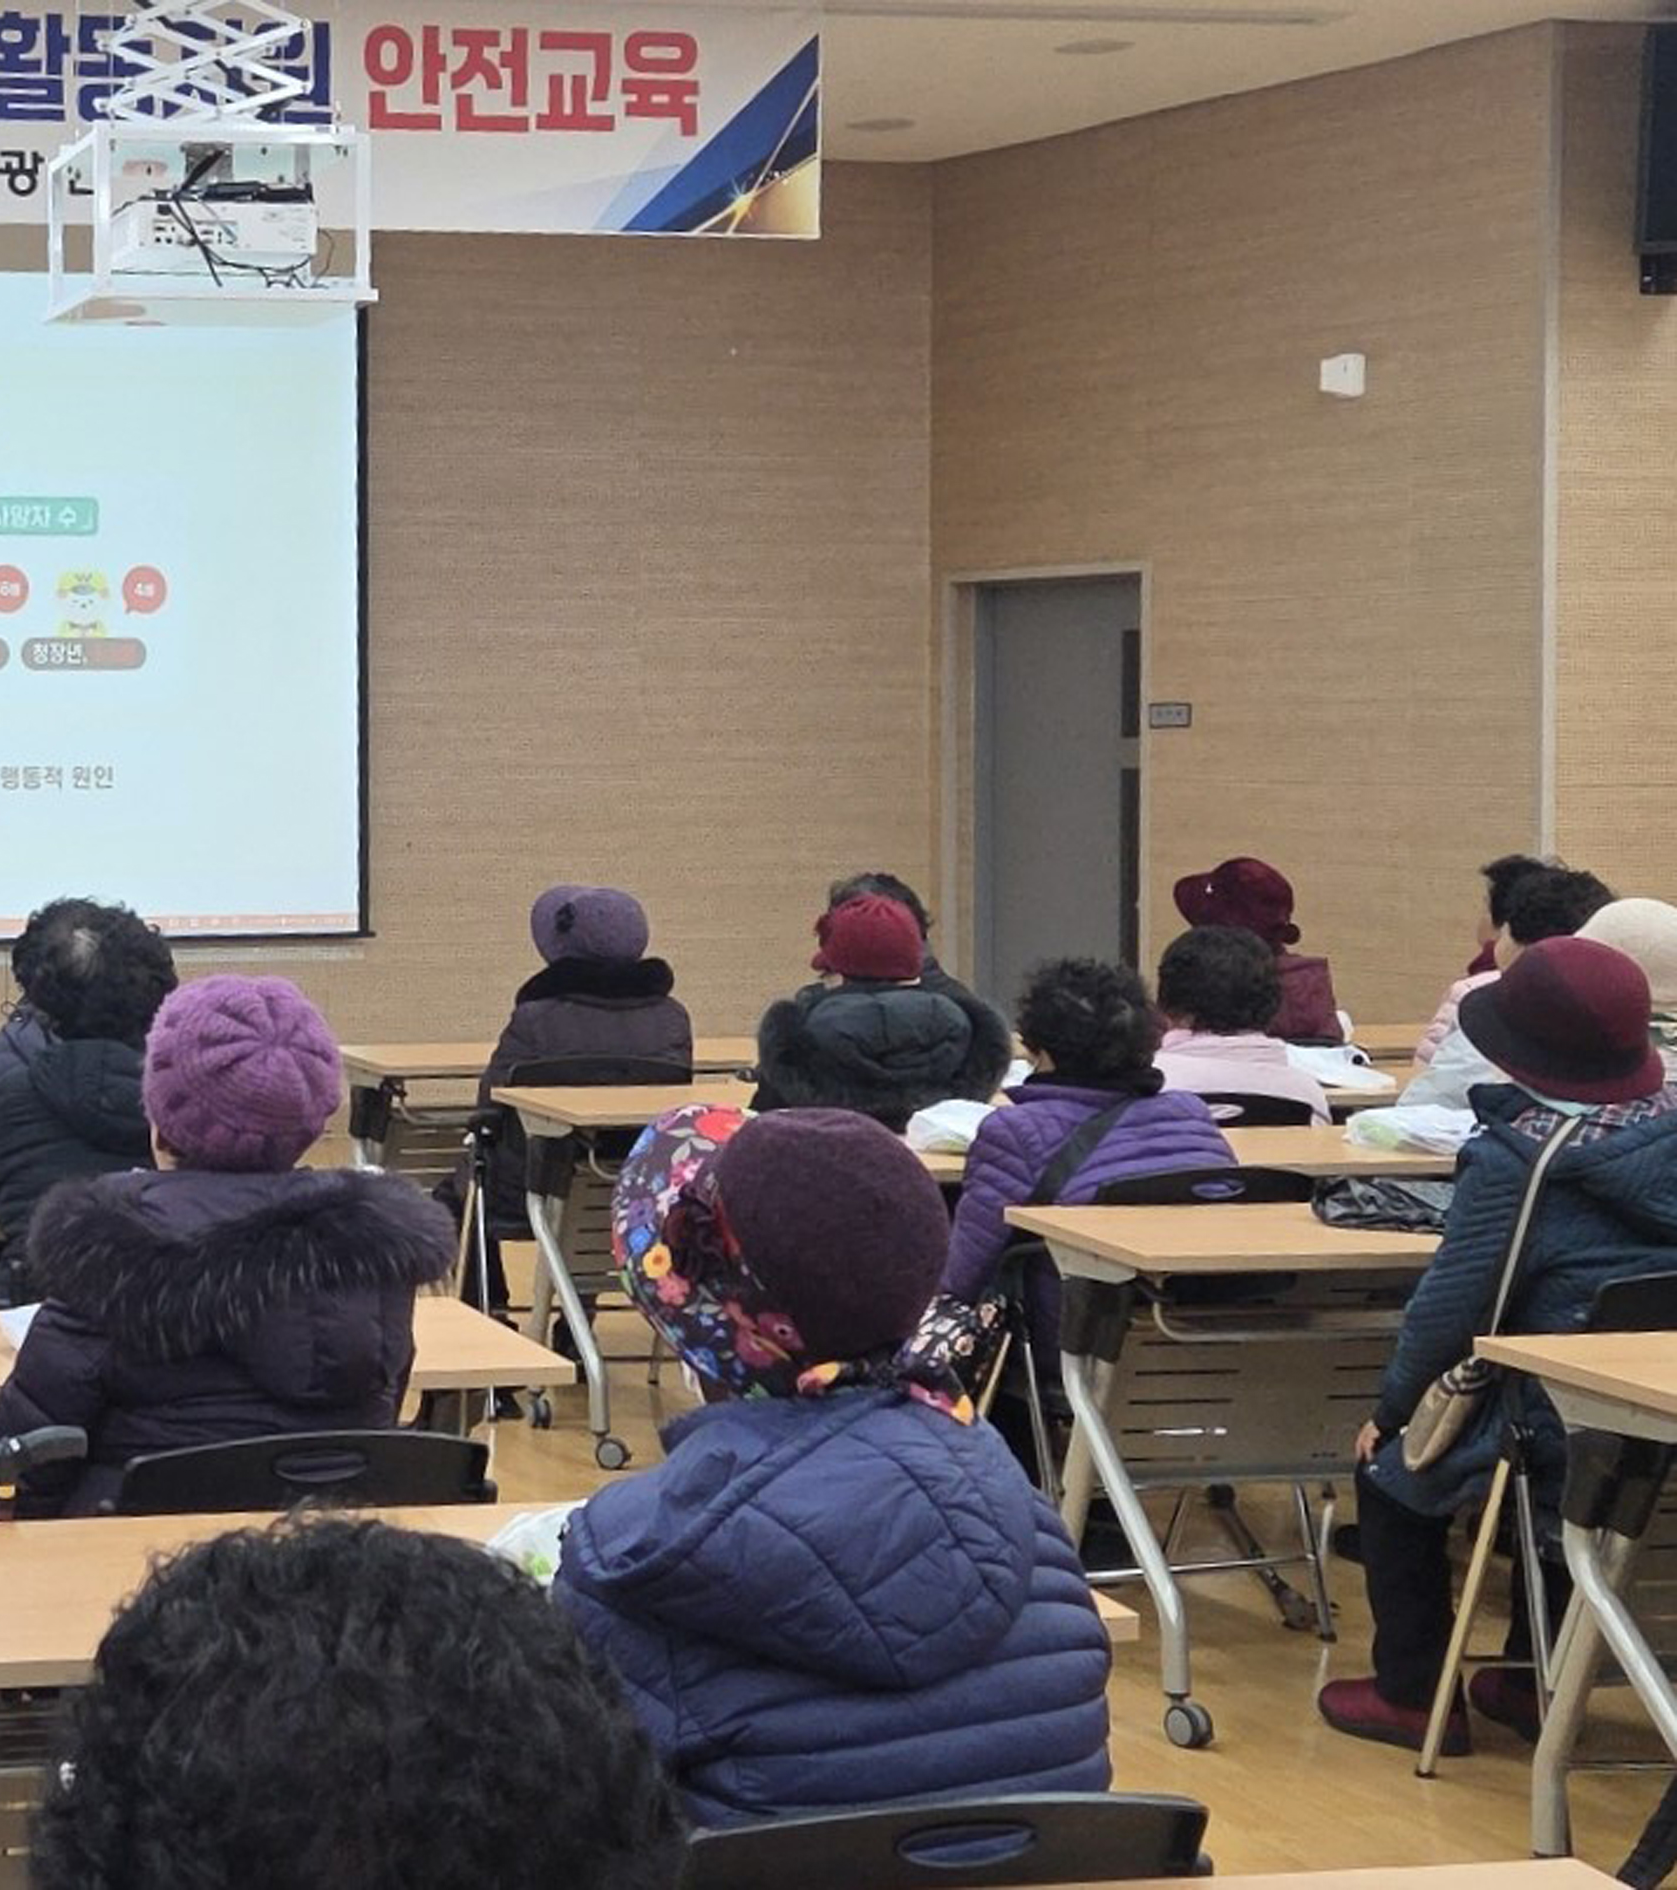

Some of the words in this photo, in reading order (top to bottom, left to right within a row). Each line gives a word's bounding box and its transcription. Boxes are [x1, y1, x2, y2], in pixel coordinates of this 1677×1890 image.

[363, 24, 700, 136] 안전교육
[0, 765, 63, 791] 행동적
[71, 766, 114, 790] 원인
